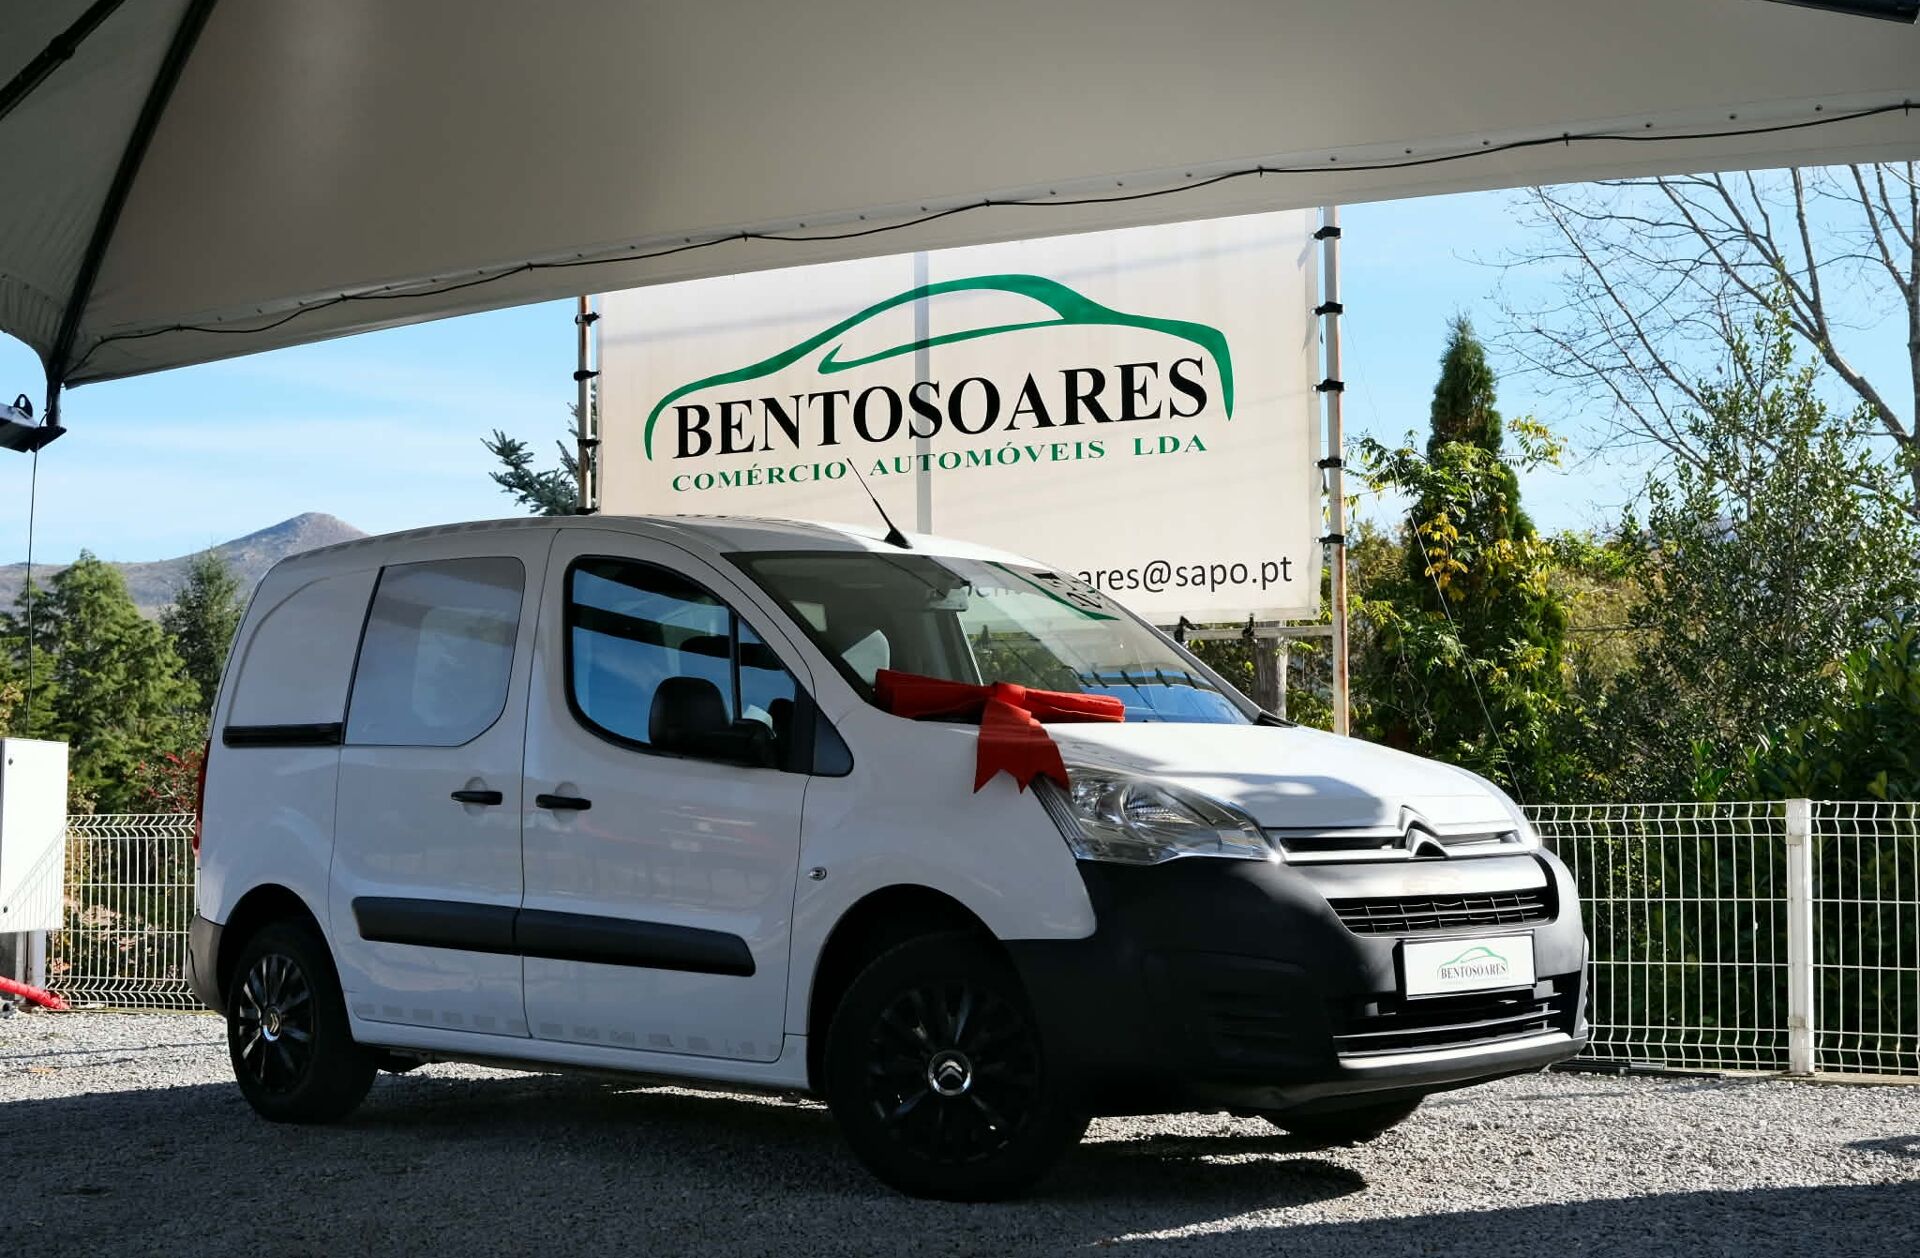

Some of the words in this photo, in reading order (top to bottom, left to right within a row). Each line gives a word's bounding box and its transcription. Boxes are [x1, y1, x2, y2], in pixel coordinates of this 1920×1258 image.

[672, 357, 1208, 459] BENTOSOARES
[672, 462, 847, 492] COMÉRCIO
[869, 438, 1106, 477] AUTOMÓVEIS
[1134, 433, 1207, 457] LDA
[1077, 556, 1293, 594] ares@sapo.pt
[1441, 963, 1507, 979] BENTOSOARES
